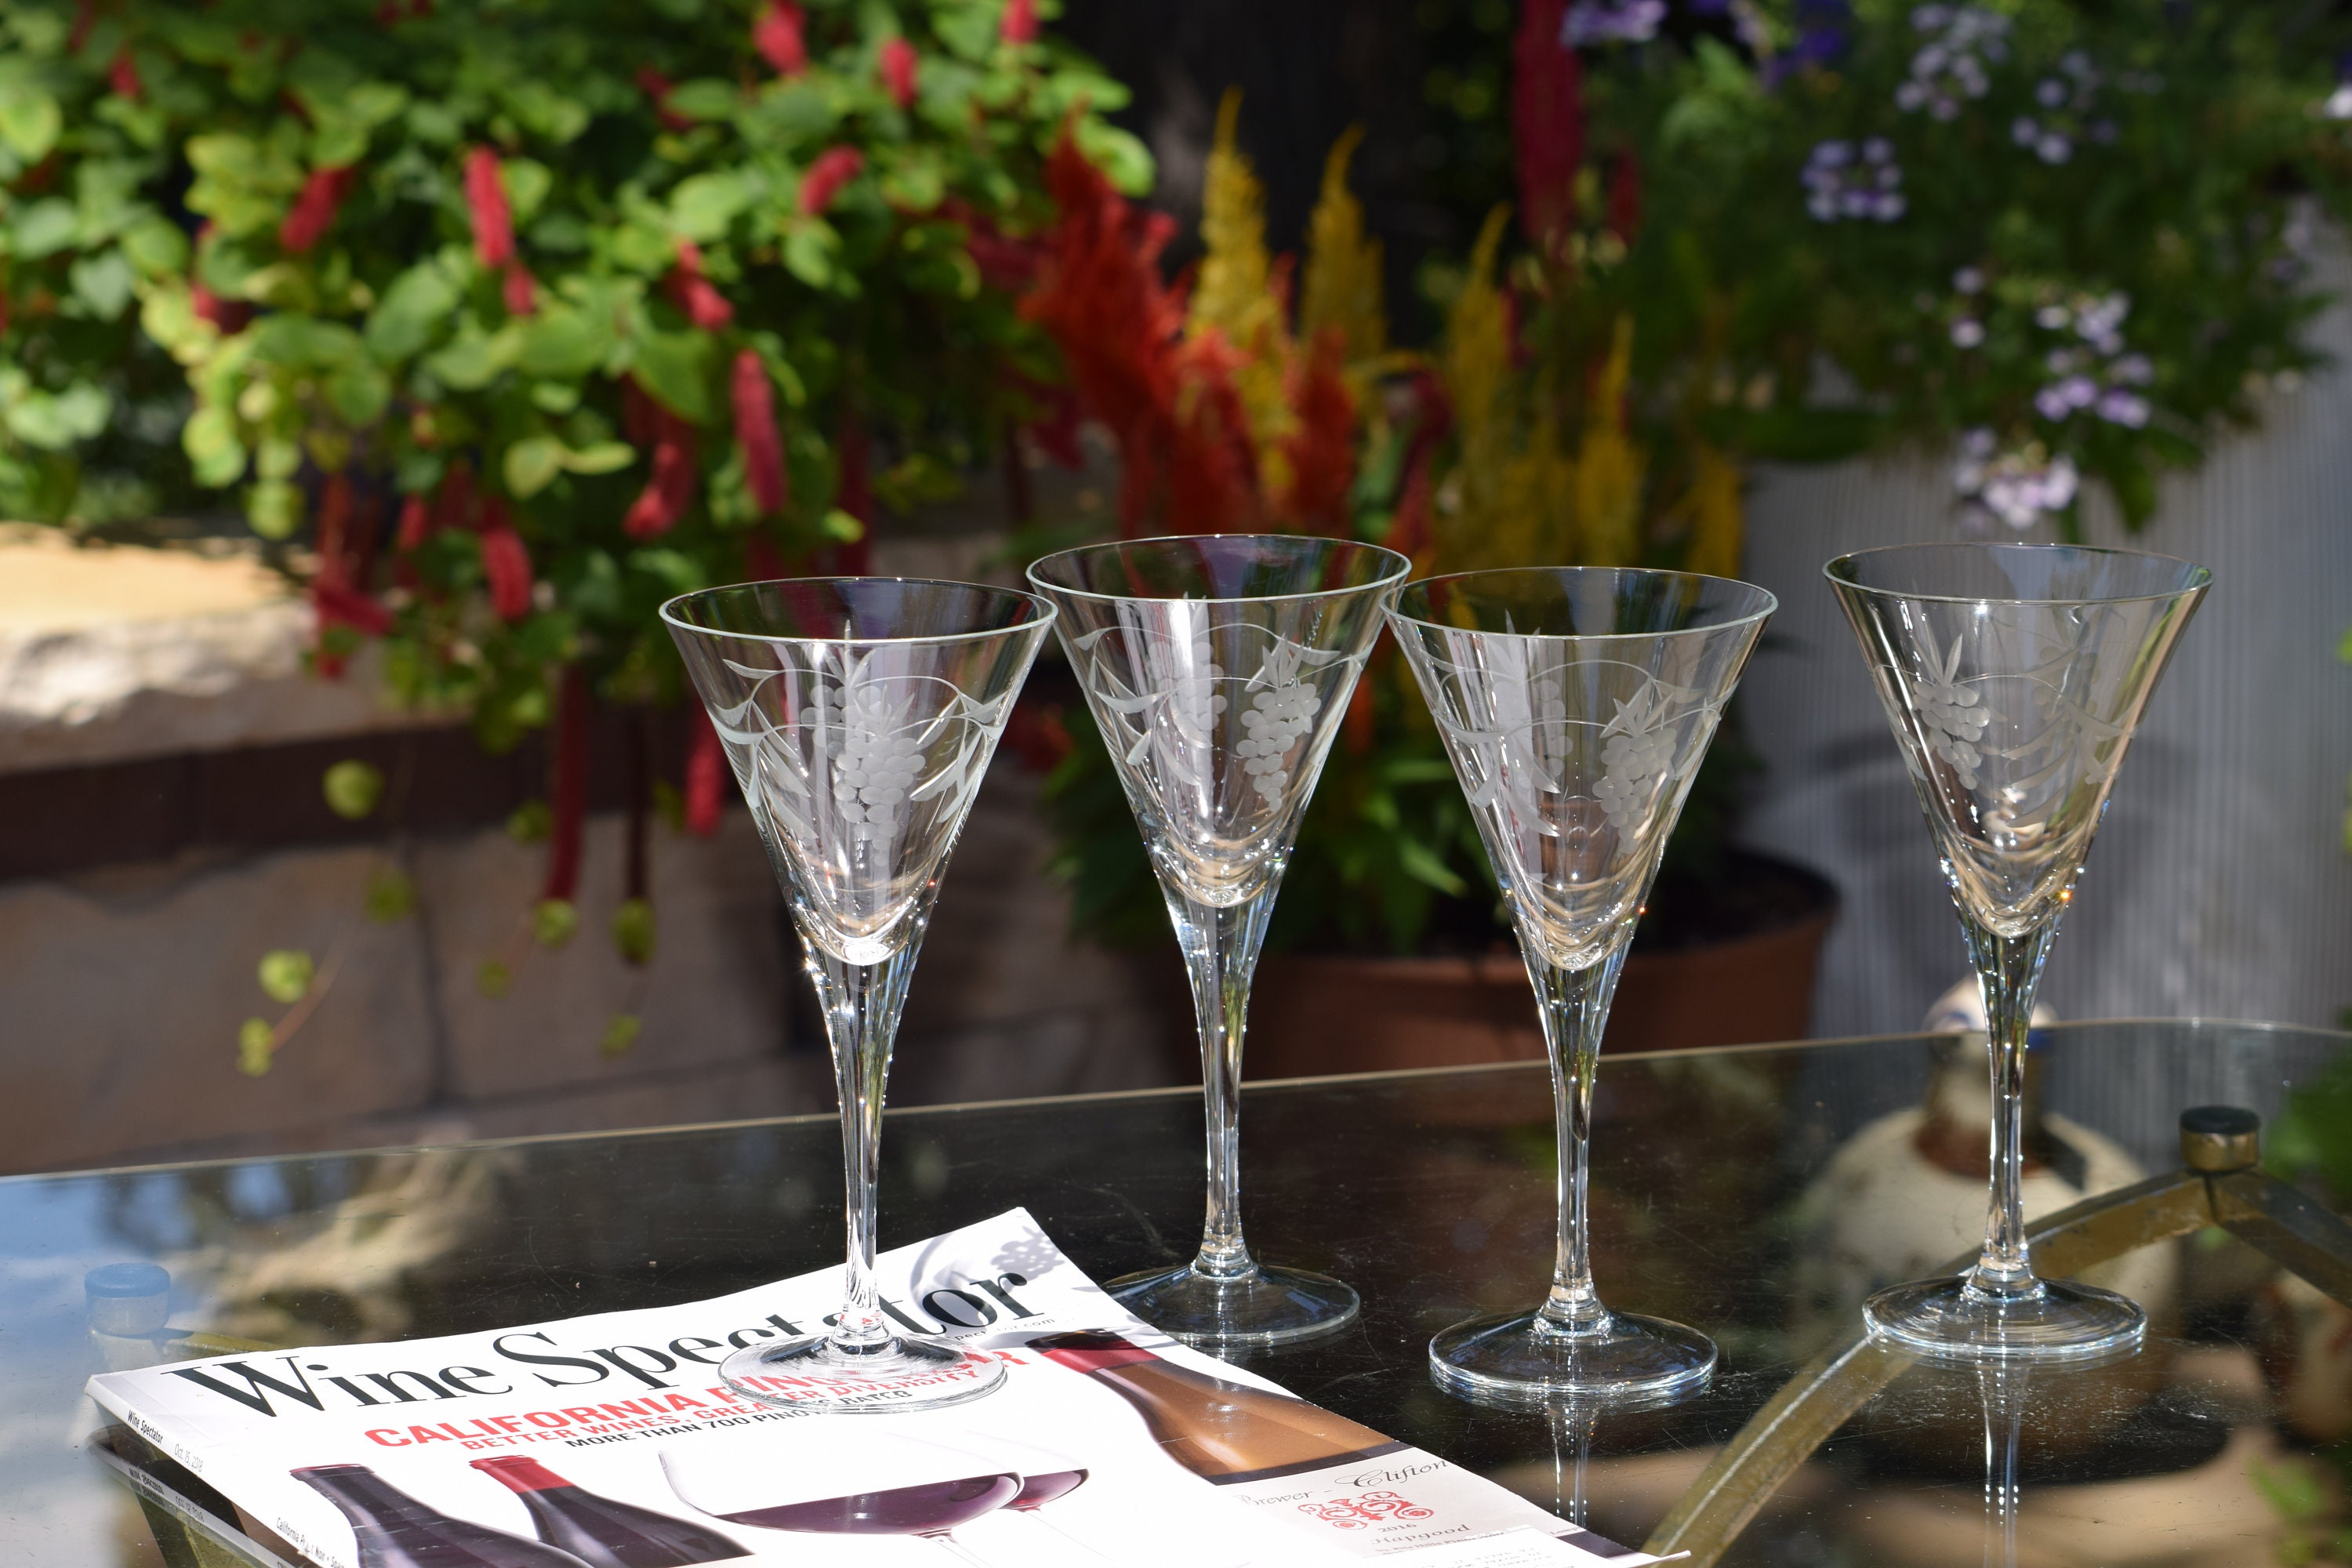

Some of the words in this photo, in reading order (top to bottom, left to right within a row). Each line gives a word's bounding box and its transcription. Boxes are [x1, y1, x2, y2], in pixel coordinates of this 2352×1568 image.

[159, 1356, 513, 1417] Wine
[128, 1410, 140, 1428] Wine
[140, 1420, 163, 1444] Spectator
[364, 1393, 710, 1447] CALIFORNIA
[460, 1428, 579, 1450] BETTER
[579, 1415, 691, 1435] WINES,
[564, 1432, 637, 1447] MORE
[634, 1423, 703, 1438] THAN
[702, 1417, 750, 1428] 700
[1232, 1490, 1315, 1507] Brewer
[1334, 1460, 1450, 1487] Clifton
[1371, 1524, 1472, 1544] Hapgood
[1377, 1523, 1417, 1533] 2016
